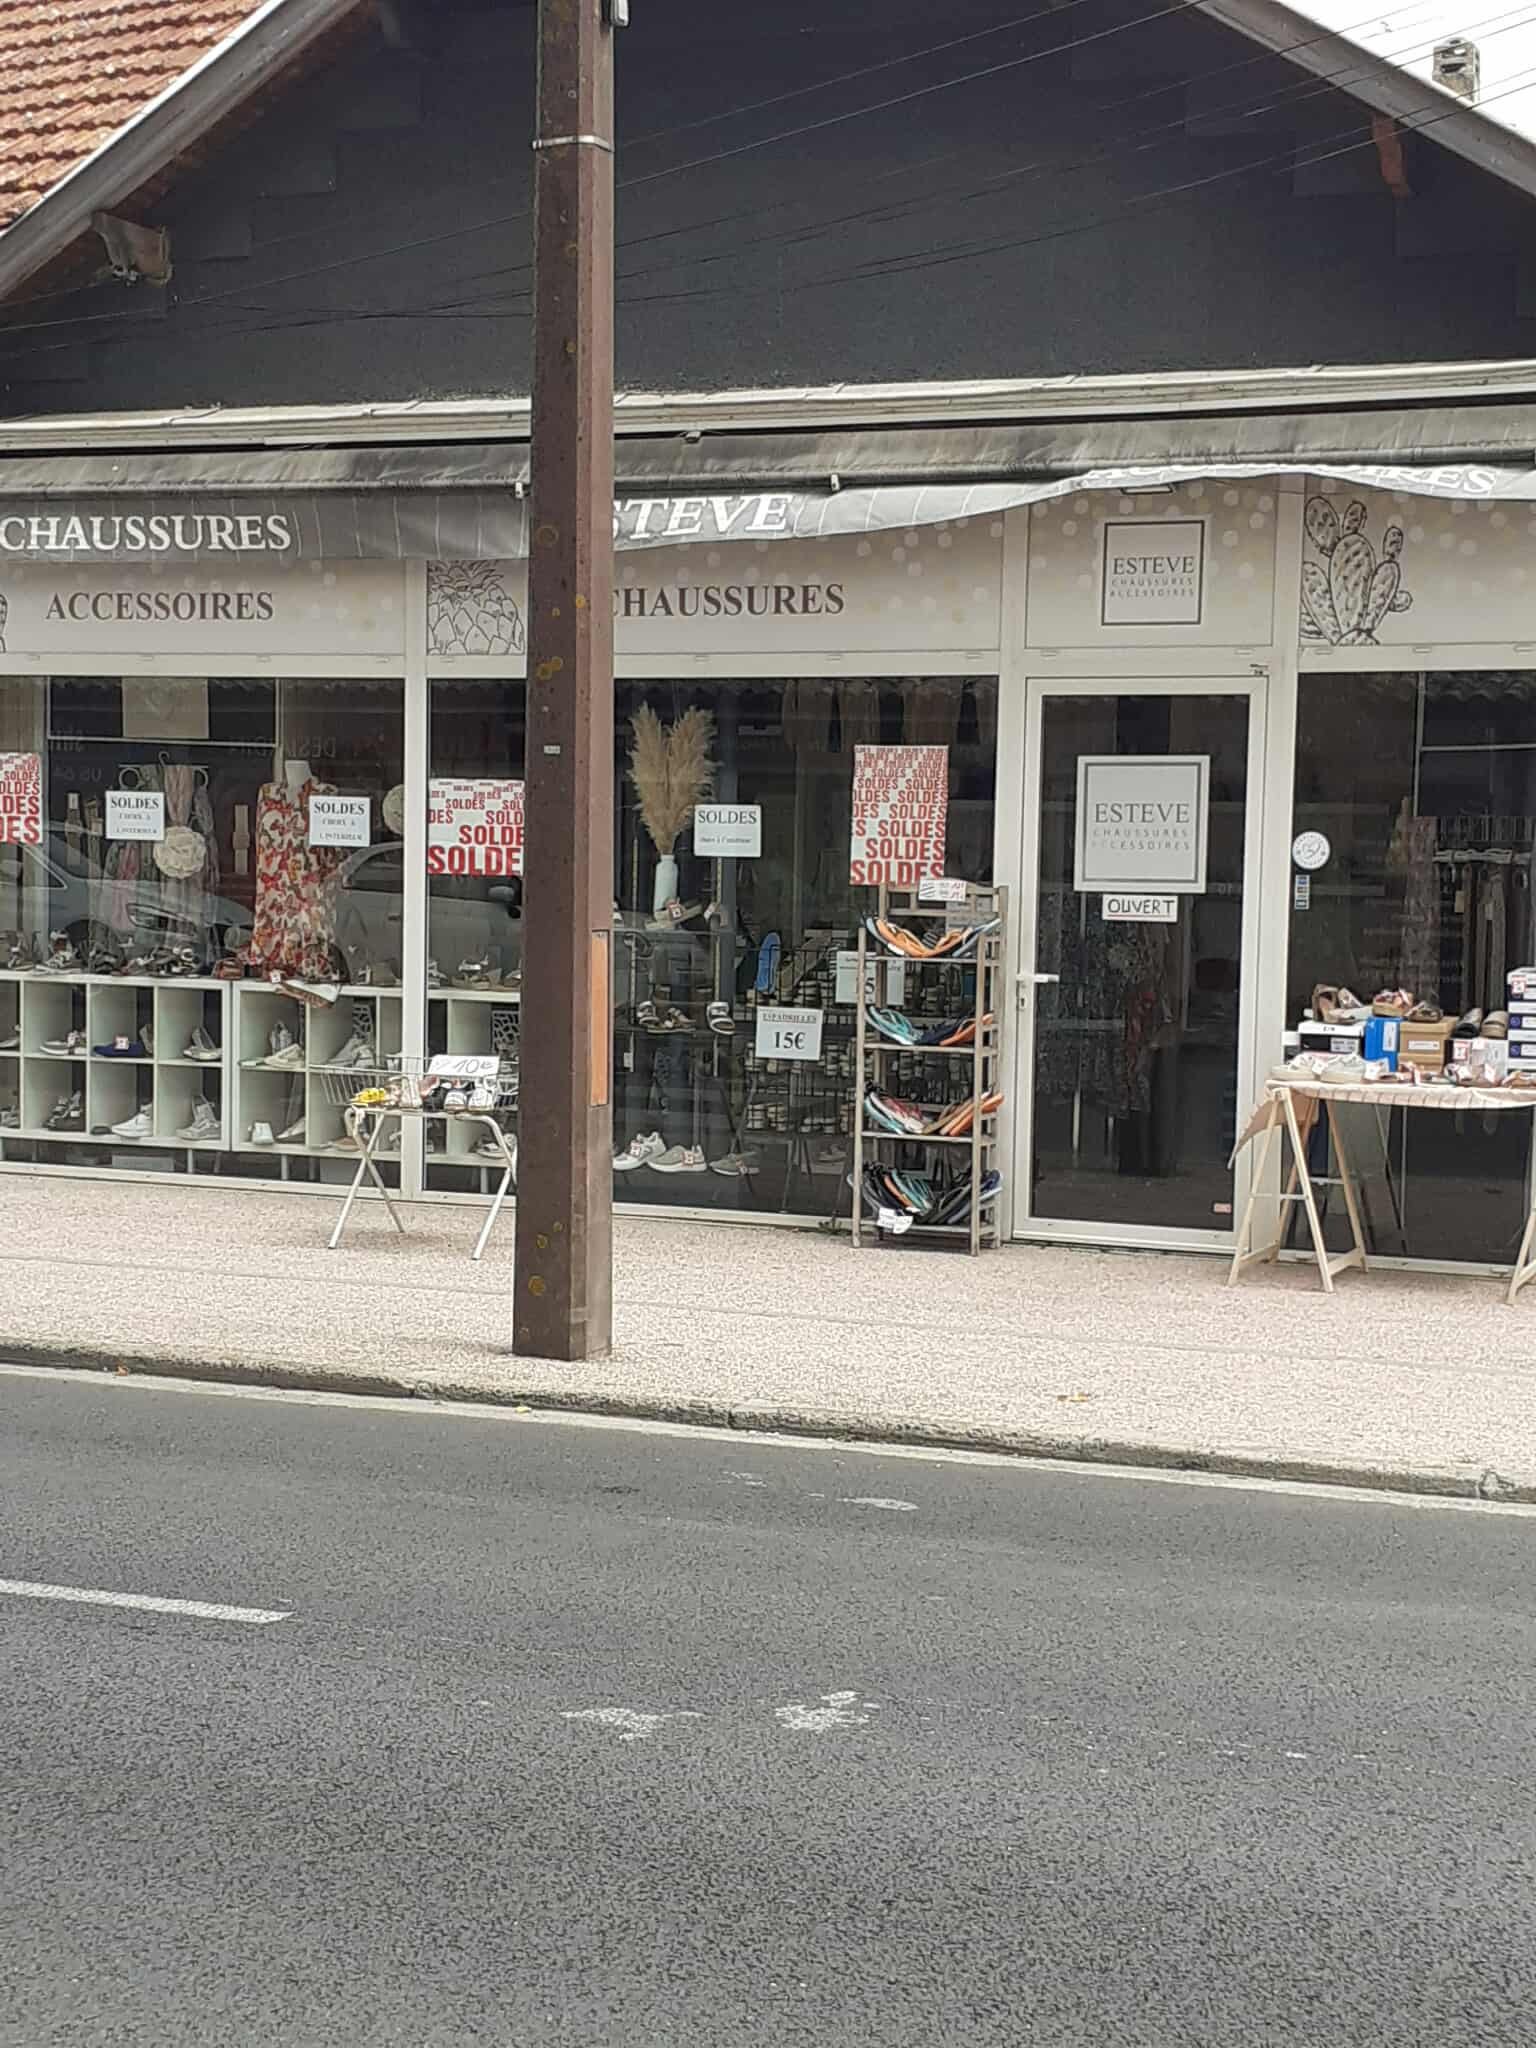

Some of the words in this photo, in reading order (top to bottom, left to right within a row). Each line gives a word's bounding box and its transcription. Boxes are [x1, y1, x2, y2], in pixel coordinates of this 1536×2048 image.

[0, 515, 291, 550] CHAUSSURES
[1113, 555, 1195, 575] ESTEVE
[46, 592, 274, 620] ACCESSOIRES
[613, 583, 844, 617] HAUSSURES
[857, 778, 899, 790] SOLDES
[904, 778, 948, 791] SOLDES
[110, 797, 159, 809] SOLDES
[445, 799, 486, 810] SOLDES
[897, 790, 949, 804] SOLDES
[313, 801, 365, 815] SOLDES
[889, 804, 947, 820] SOLDES
[1095, 802, 1190, 824] ESTEVE
[698, 810, 757, 825] SOLDES
[878, 820, 945, 838] SOLDES
[865, 838, 945, 861] SOLDES
[850, 859, 945, 889] SOLDES
[1107, 898, 1175, 914] OUVERT
[774, 1031, 806, 1050] 15€
